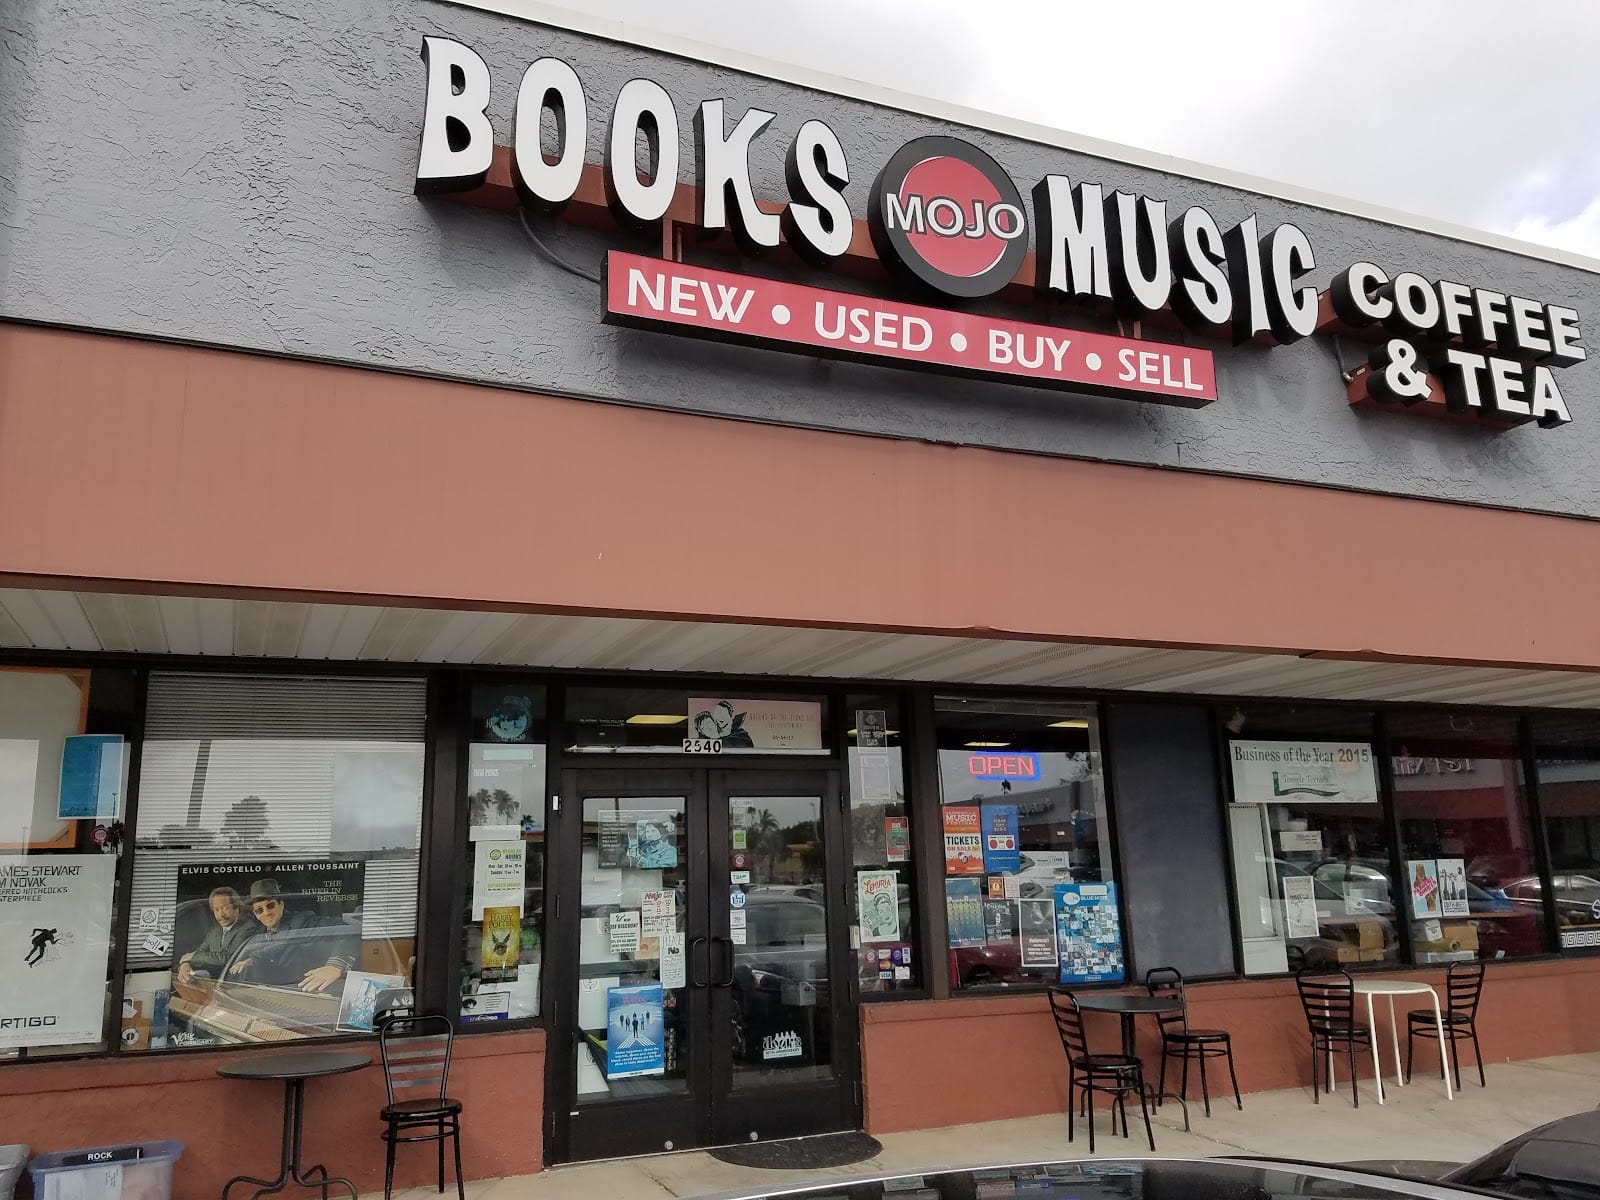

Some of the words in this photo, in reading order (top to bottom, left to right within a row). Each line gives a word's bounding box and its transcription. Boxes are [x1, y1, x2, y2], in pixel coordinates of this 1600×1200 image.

[416, 36, 854, 257] BOOKS
[886, 193, 1026, 239] MOJO
[1042, 174, 1320, 338] MUSIC
[1348, 261, 1587, 361] COFFEE
[627, 269, 756, 324] NEW
[814, 301, 934, 354] USED
[988, 327, 1072, 372] BUY
[1118, 348, 1204, 392] SELL
[1384, 339, 1433, 400] &
[1447, 348, 1574, 423] TEA
[683, 739, 723, 754] 2540
[1234, 746, 1281, 762] Business
[1284, 747, 1295, 762] of
[1295, 748, 1312, 762] the
[1313, 748, 1335, 763] Year
[1338, 748, 1369, 763] 2015
[968, 755, 1035, 776] OPEN
[945, 836, 980, 846] TICKETS
[32, 865, 83, 876] STEWART
[182, 867, 210, 875] ELVIS
[213, 865, 262, 874] COSTELLO
[274, 864, 305, 872] ALLEN
[307, 862, 360, 871] TOUSSAINT
[10, 877, 47, 888] NOVAK
[323, 880, 343, 888] THE
[316, 894, 358, 902] REVERSE
[490, 912, 514, 922] HARRY
[488, 920, 514, 929] POTTER
[0, 1015, 57, 1029] RTIGO
[87, 1151, 113, 1161] ROCK
